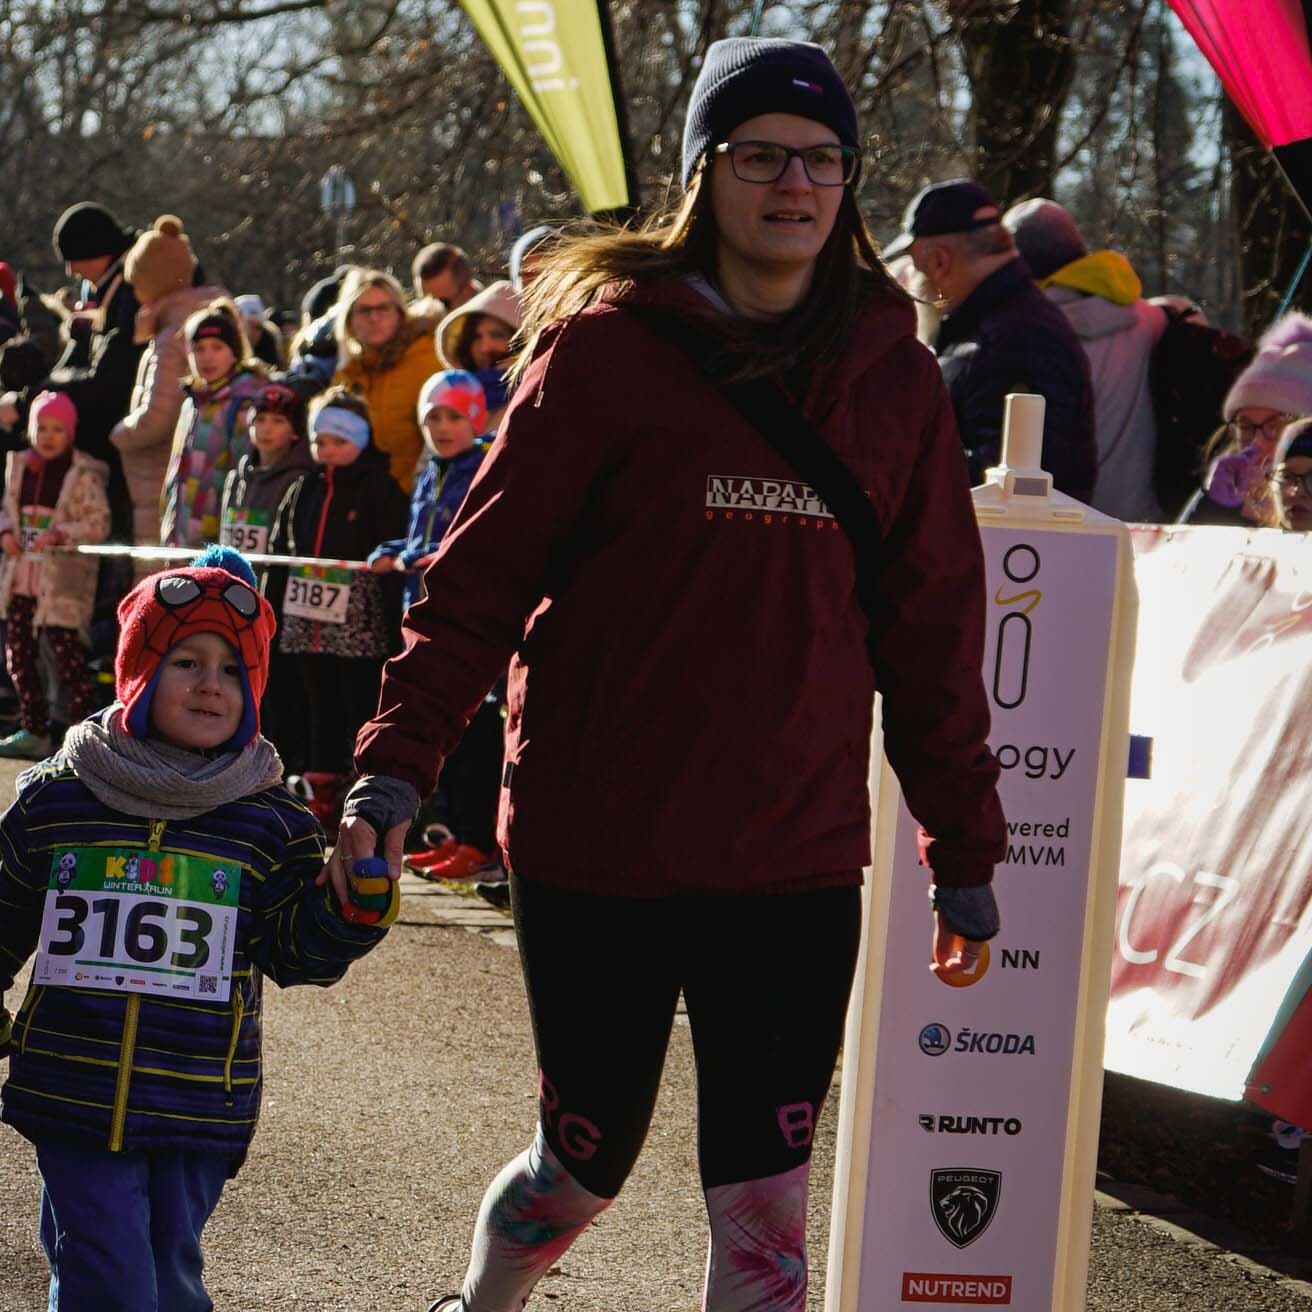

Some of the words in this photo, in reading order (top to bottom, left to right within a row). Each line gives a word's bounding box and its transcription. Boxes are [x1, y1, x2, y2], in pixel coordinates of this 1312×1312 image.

[289, 578, 341, 609] 3187
[996, 744, 1076, 781] ogy
[1006, 844, 1066, 866] MVM
[48, 895, 213, 970] 3163
[1001, 949, 1041, 969] NN
[954, 1027, 1035, 1055] ŠKODA
[938, 1115, 1022, 1136] RUNTO
[937, 1174, 994, 1185] PEUGEOT
[908, 1279, 1007, 1299] NUTREND
